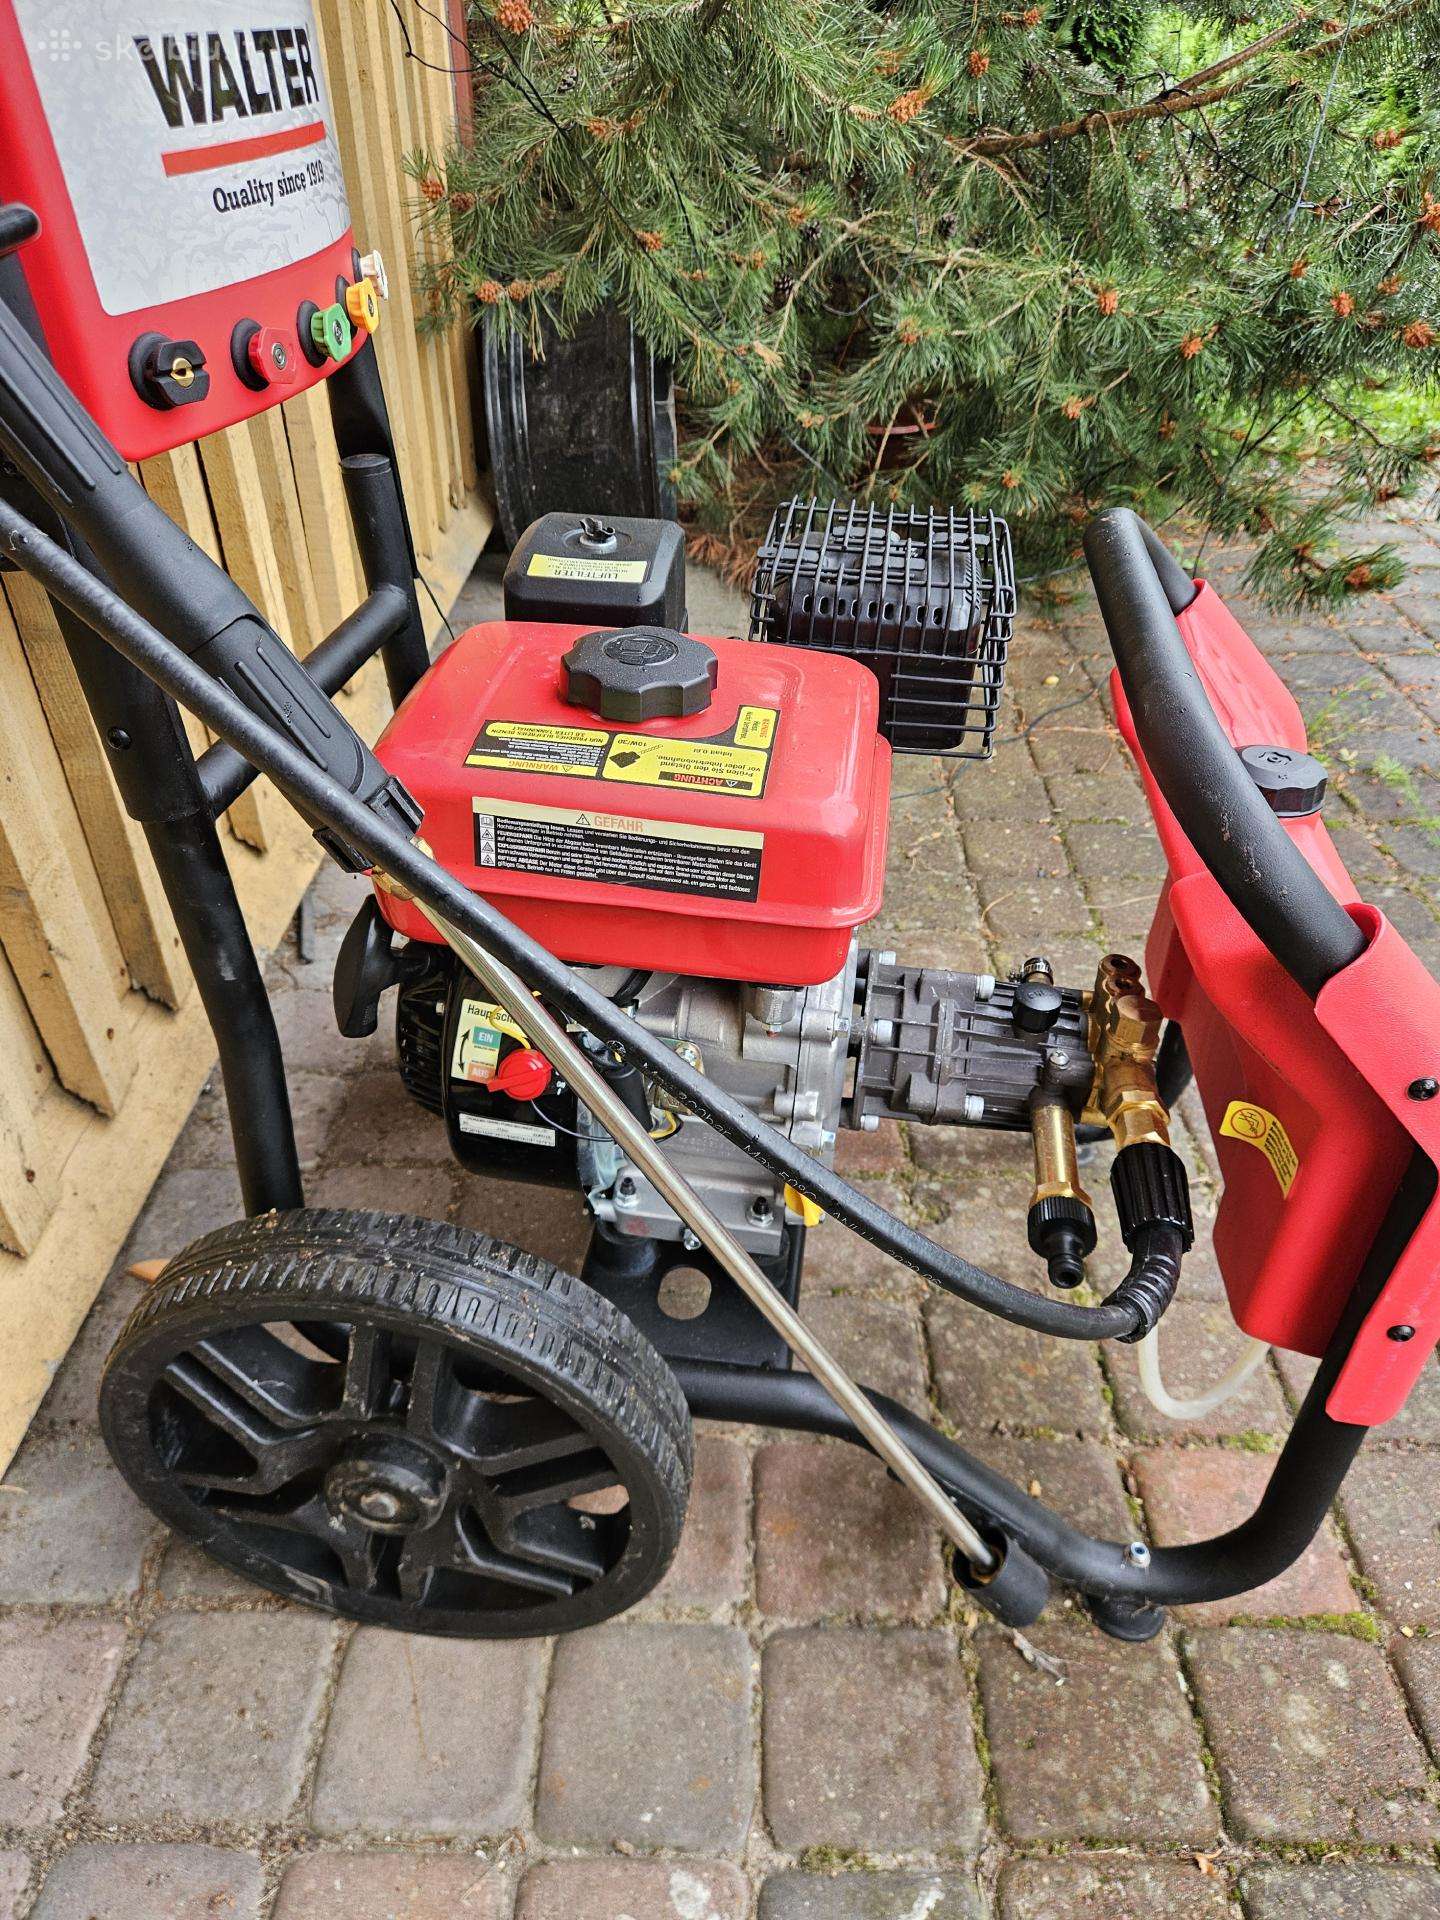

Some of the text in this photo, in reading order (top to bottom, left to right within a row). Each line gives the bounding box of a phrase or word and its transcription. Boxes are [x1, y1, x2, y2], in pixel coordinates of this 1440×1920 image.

[133, 28, 319, 128] WALTER
[213, 159, 324, 213] Quality since 1919
[506, 760, 559, 770] WARNUNG
[725, 768, 753, 777] Prüfen
[672, 773, 723, 786] ACHTUNG
[594, 815, 643, 832] GEFAHR
[467, 1004, 516, 1022] Haupsch
[478, 1032, 494, 1043] EIN
